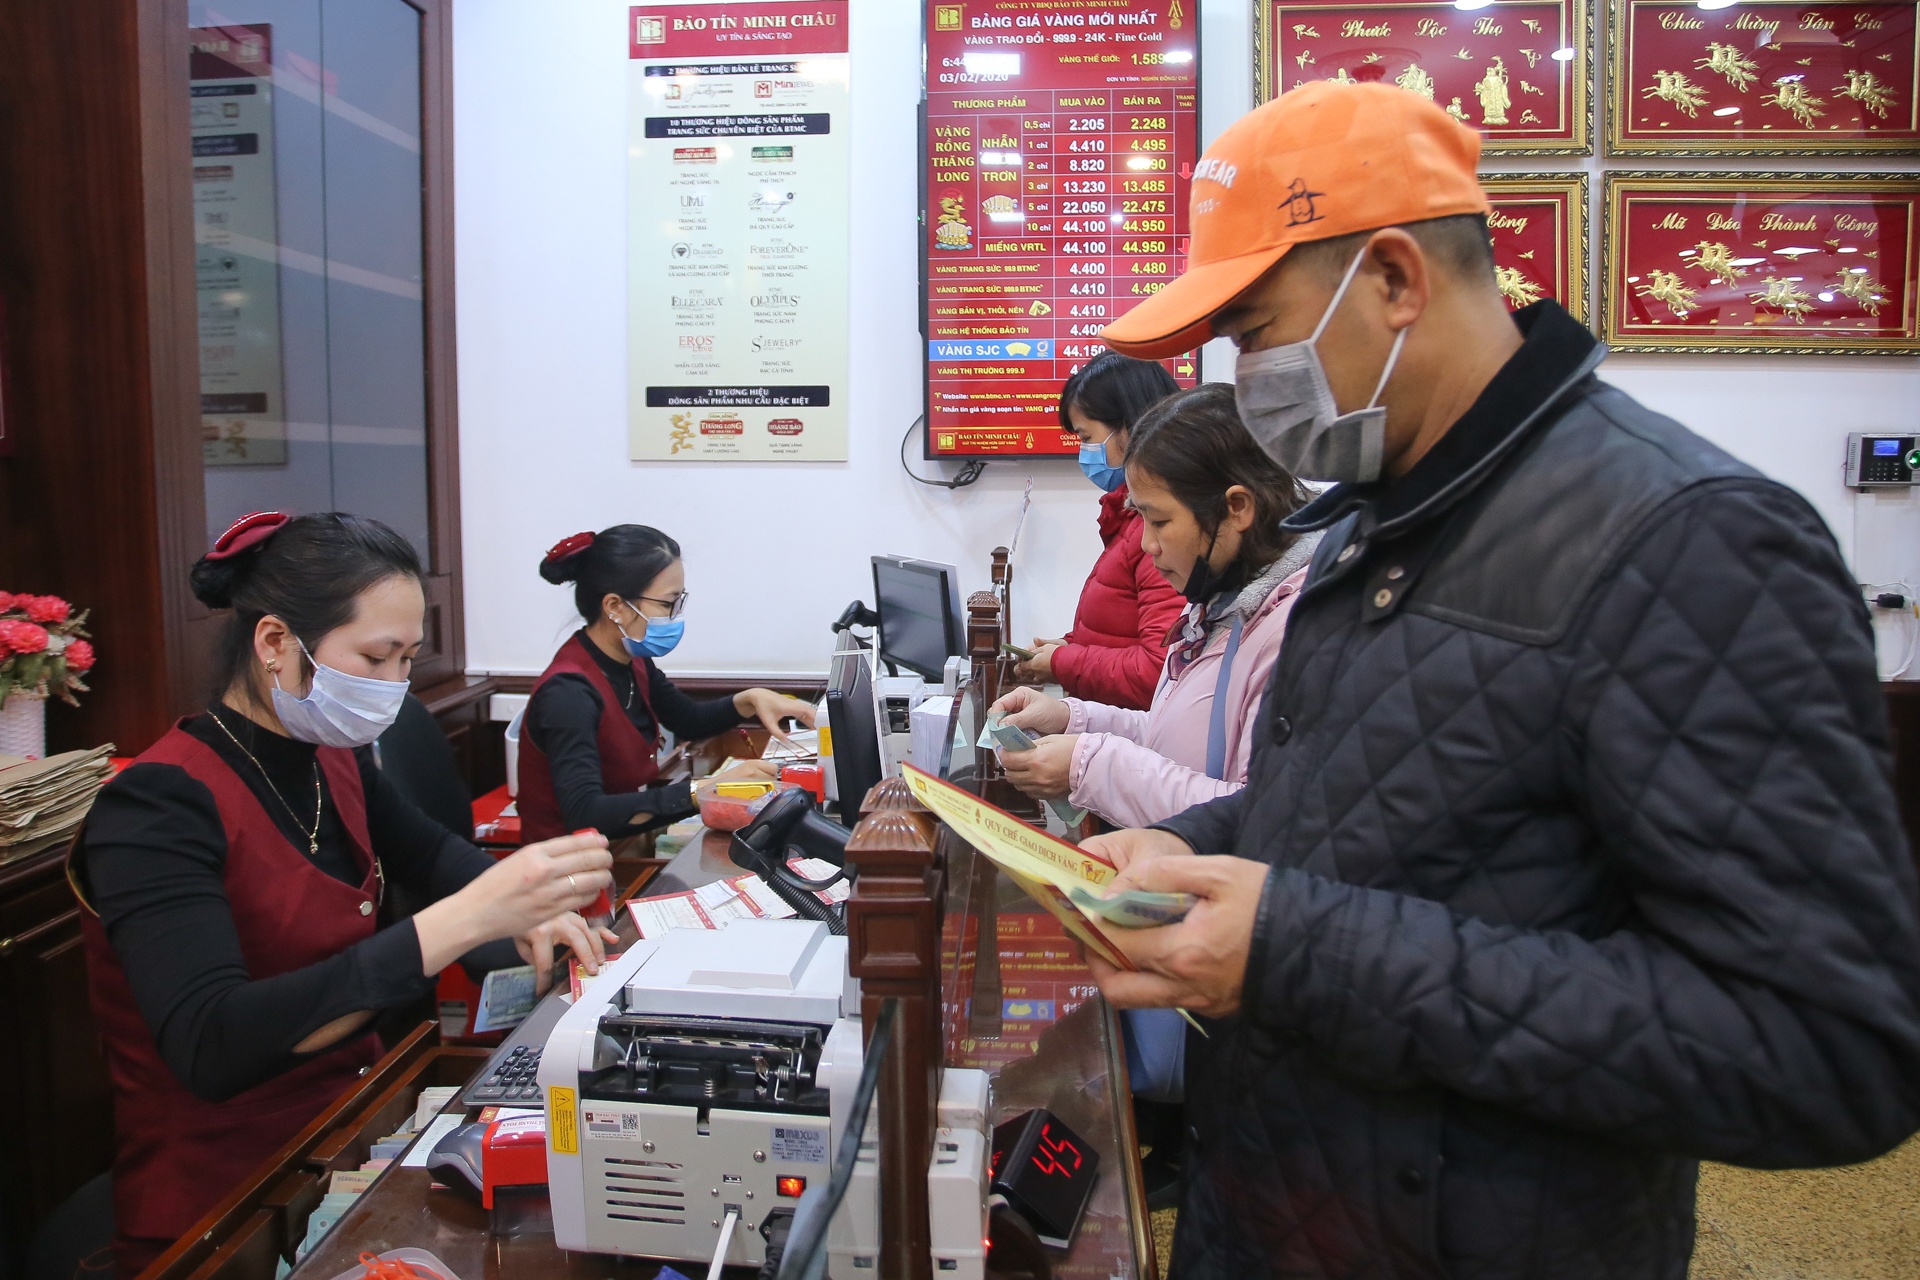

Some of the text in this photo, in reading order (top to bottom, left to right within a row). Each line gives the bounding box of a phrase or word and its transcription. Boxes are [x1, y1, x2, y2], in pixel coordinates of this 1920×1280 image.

[710, 13, 737, 29] TÍN
[743, 15, 786, 28] MINH
[791, 12, 836, 26] CHÂU
[971, 9, 1157, 28] BẢNG GIÁ VÀNG MỚI NHẤT
[1658, 12, 1884, 36] Chúc Mừng Tân Gia
[1340, 17, 1503, 38] Phước Lộc Thọ
[964, 31, 1162, 44] VÀNG TRAO ĐỔI 999.9 24K Fine Gold
[1059, 55, 1081, 63] VÀNG
[1083, 54, 1099, 63] THẾ
[952, 95, 1026, 108] THƯƠNG PHẨM
[1059, 96, 1105, 106] MUA VÀO
[1123, 95, 1161, 105] BÁN RA
[1069, 119, 1105, 130] 2.205
[1131, 118, 1166, 130] 2.248
[747, 126, 764, 134] BIỆT
[936, 125, 971, 137] VÀNG
[936, 138, 971, 152] RỒNG
[982, 134, 1018, 148] NHẪN
[1028, 141, 1033, 149] 1
[1069, 140, 1105, 152] 4.410
[1131, 140, 1166, 151] 4.495
[932, 155, 975, 167] THĂNG
[1028, 161, 1034, 170] 2
[1070, 160, 1105, 171] 8.820
[937, 172, 970, 182] LONG
[982, 171, 1017, 181] TRƠN
[1028, 182, 1034, 190] 3
[1063, 181, 1106, 193] 13.230
[1123, 180, 1165, 192] 13.485
[1028, 202, 1034, 210] 5
[1063, 202, 1106, 214] 22.050
[1123, 201, 1165, 212] 22.475
[1027, 223, 1038, 231] 10
[1063, 221, 1106, 232] 44.100
[1123, 220, 1165, 232] 44.950
[1652, 211, 1879, 238] Mã Đáo Thành Công
[985, 240, 1047, 252] MIẾNG VRTL
[1063, 242, 1106, 254] 44.100
[1122, 241, 1165, 253] 44.950
[936, 265, 957, 273] VÀNG
[986, 264, 1001, 272] SỨC
[1070, 263, 1105, 274] 4.400
[1131, 263, 1166, 274] 4.480
[936, 285, 957, 293] VÀNG
[1070, 283, 1105, 295] 4.410
[936, 306, 957, 314] VÀNG
[959, 306, 975, 314] BẢN
[1070, 305, 1105, 316] 4.410
[960, 327, 970, 335] HỆ
[972, 326, 998, 334] THỐNG
[1000, 326, 1015, 334] BẢO
[679, 336, 712, 345] EROS
[938, 344, 1000, 355] VÀNG SJC
[937, 366, 958, 375] VÀNG
[750, 388, 769, 396] HIỆU
[694, 396, 709, 404] SẢN
[711, 396, 734, 404] PHẨM
[755, 396, 771, 404] CẦU
[792, 396, 809, 405] BIỆT
[981, 406, 995, 414] vàng
[1044, 405, 1054, 413] gửi
[984, 818, 1001, 833] QUY
[1003, 829, 1019, 842] CHẾ
[1020, 835, 1037, 852] GIAO
[1038, 847, 1056, 862] DỊCH
[1058, 854, 1078, 872] VÀNG
[1031, 1123, 1083, 1178] 45
